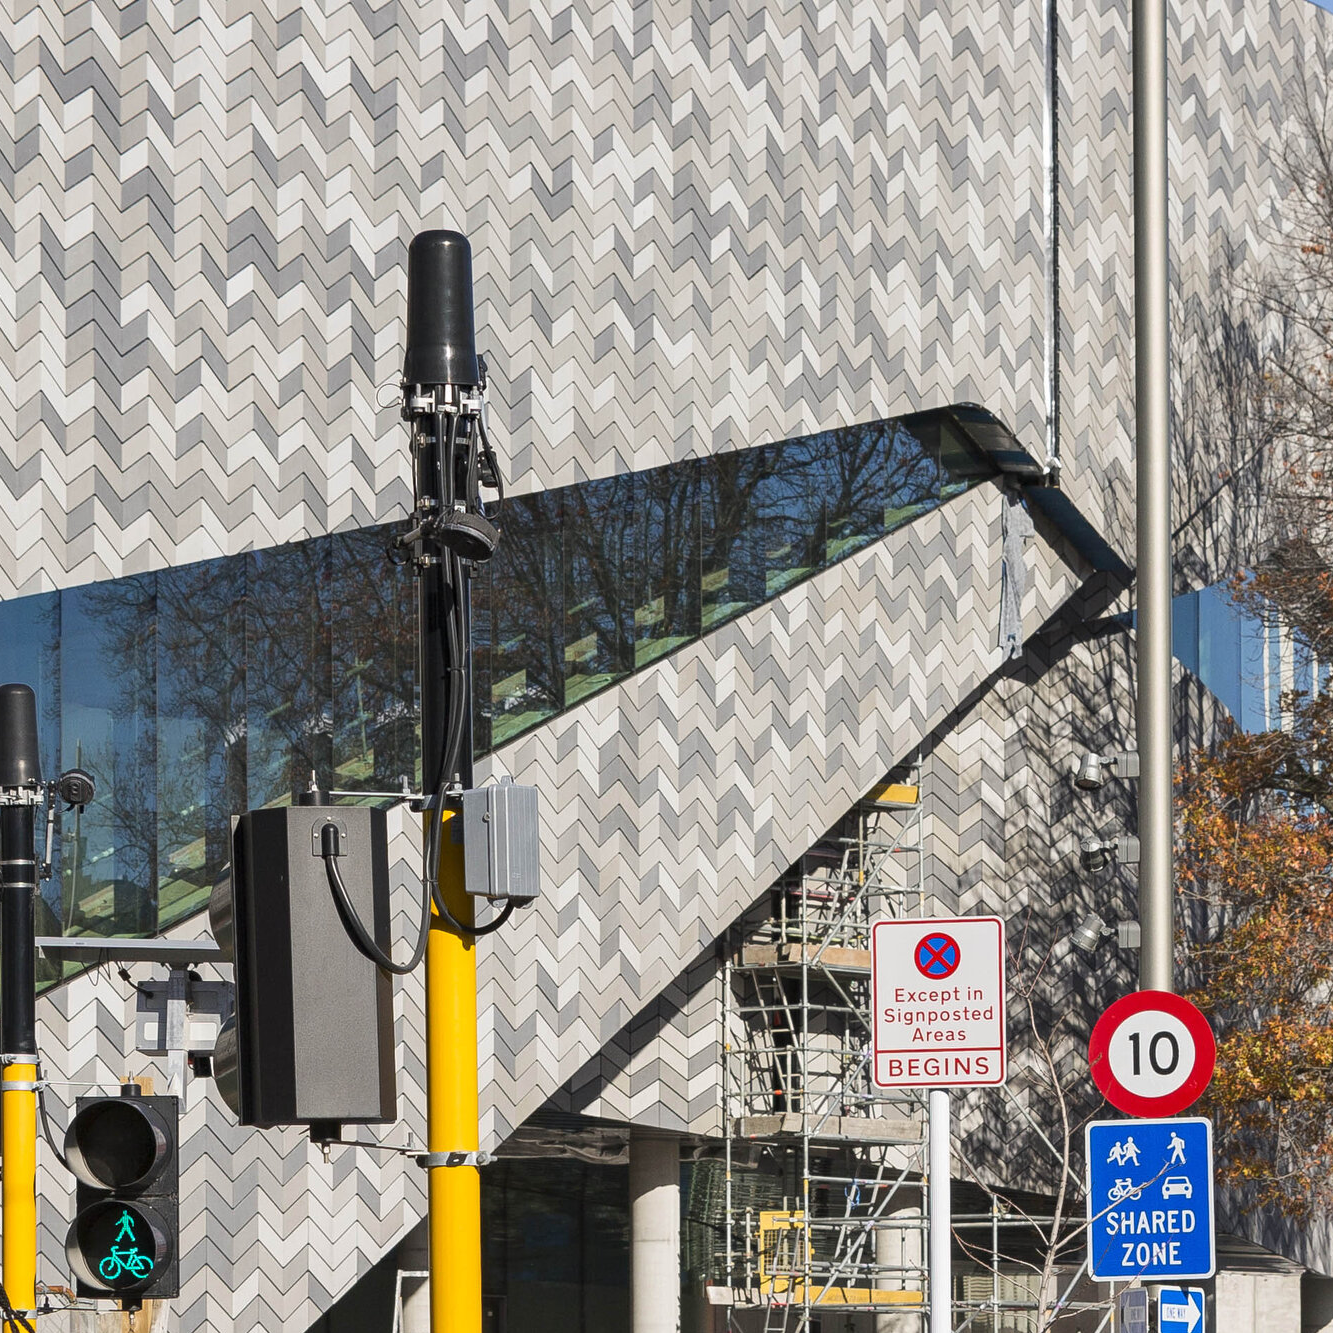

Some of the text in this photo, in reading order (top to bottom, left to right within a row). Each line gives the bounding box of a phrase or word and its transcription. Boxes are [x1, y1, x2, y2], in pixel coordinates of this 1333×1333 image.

[894, 986, 983, 1005] Except in
[884, 1006, 994, 1025] Signposted
[912, 1027, 967, 1042] Areas
[1128, 1031, 1180, 1076] 10
[889, 1057, 989, 1077] BEGINS
[1106, 1209, 1196, 1235] SHARED
[1121, 1241, 1182, 1267] ZONE
